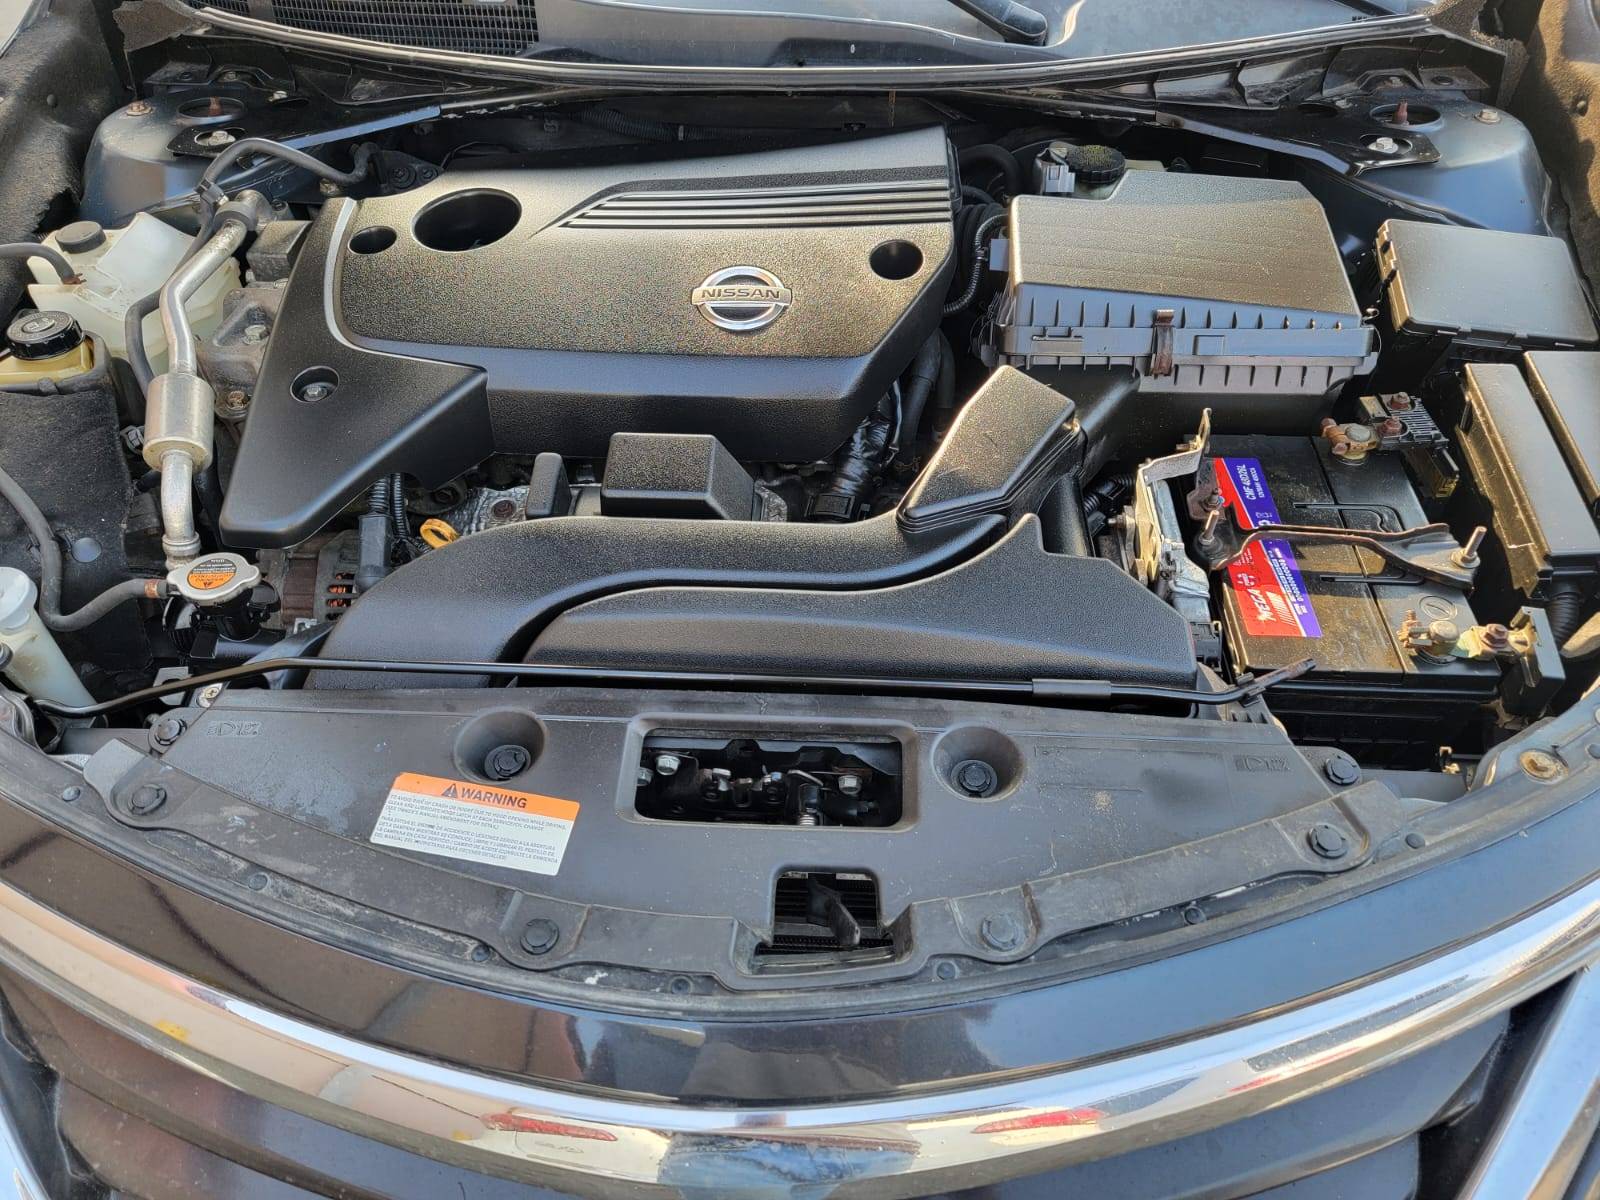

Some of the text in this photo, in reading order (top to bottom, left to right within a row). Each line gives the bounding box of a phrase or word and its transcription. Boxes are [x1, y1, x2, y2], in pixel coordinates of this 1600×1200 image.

[701, 288, 780, 299] NISSAN
[1247, 588, 1277, 622] MEGA
[462, 788, 528, 808] WARNING
